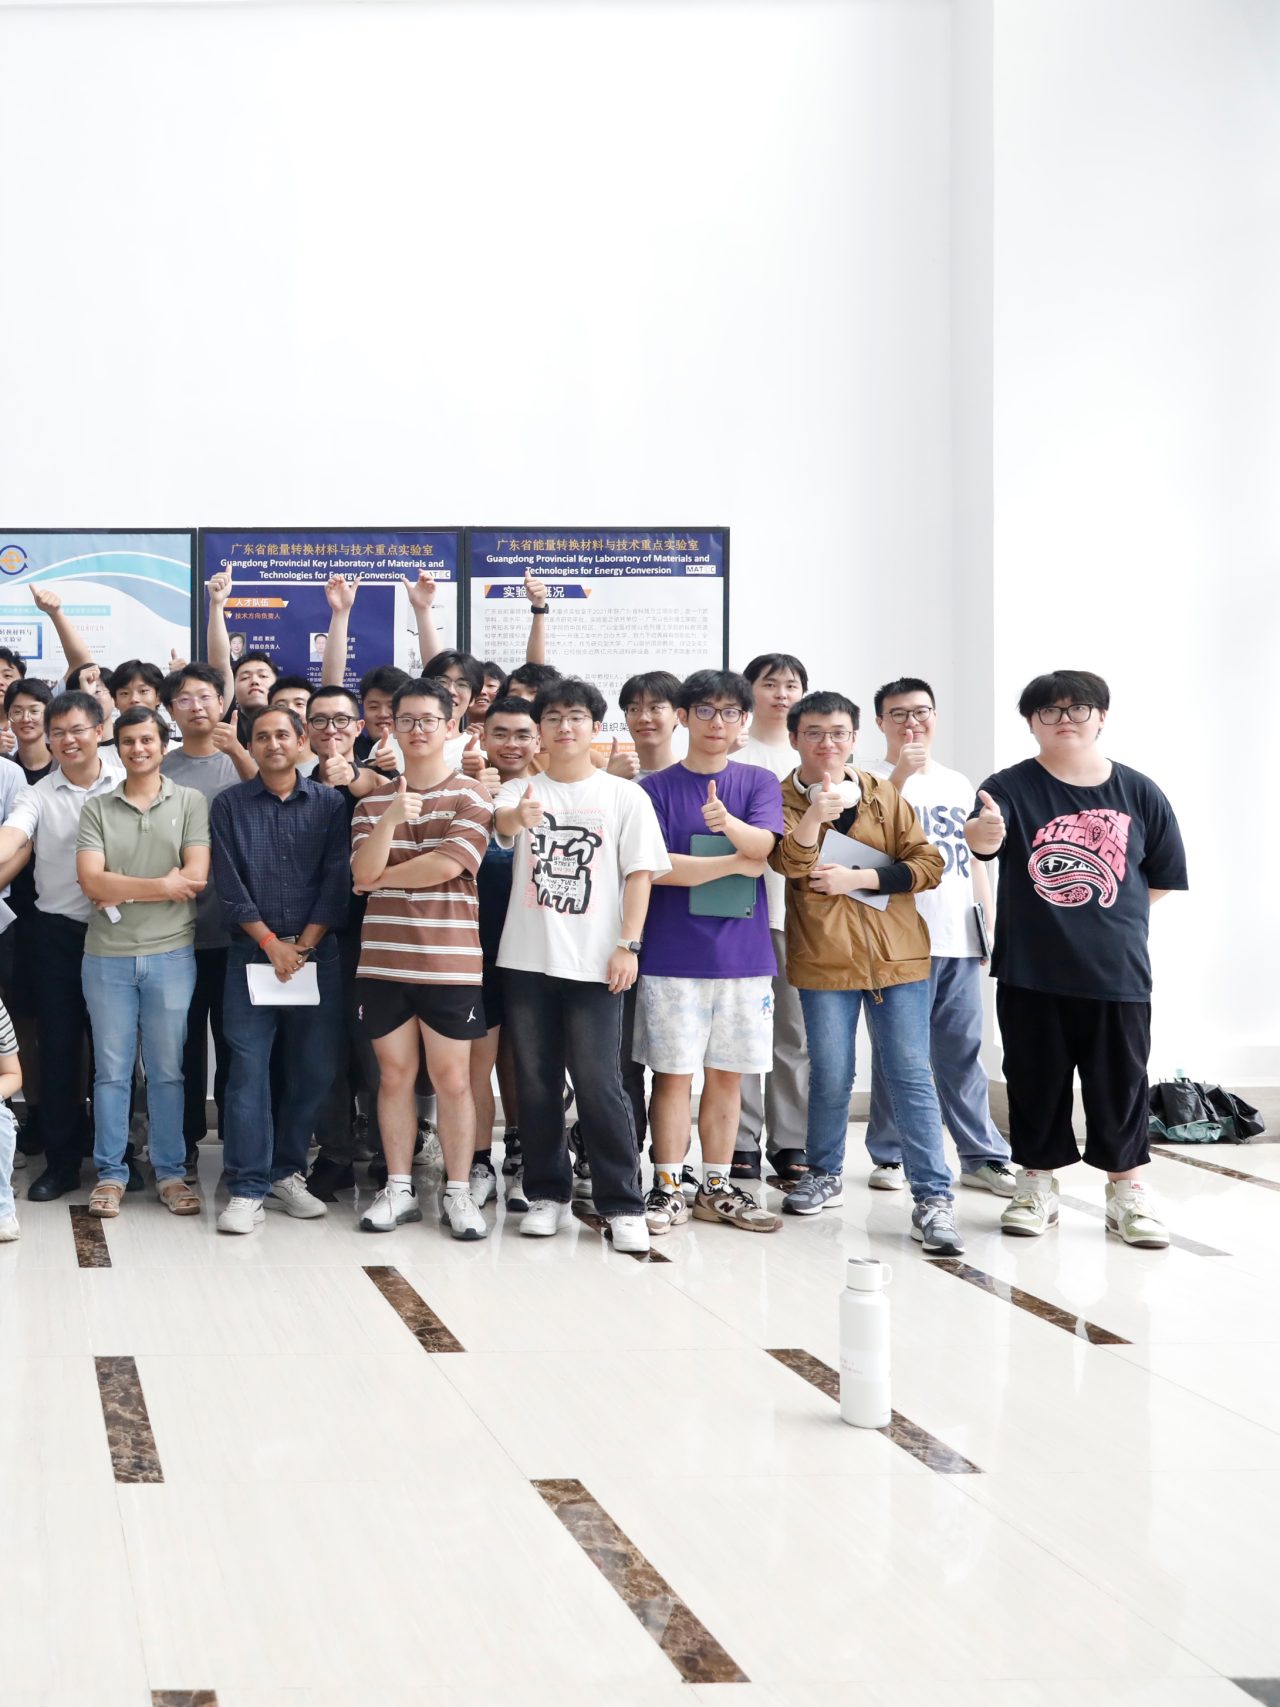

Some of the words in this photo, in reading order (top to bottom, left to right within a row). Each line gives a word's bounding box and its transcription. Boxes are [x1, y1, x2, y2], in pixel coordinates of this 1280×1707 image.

[231, 544, 433, 556] 广东省能量转换材料与技术重点实验室
[497, 539, 699, 551] 广东省能量转换材料与技术重点实验室
[220, 559, 268, 569] Guangdong
[270, 559, 310, 567] Provincial
[312, 560, 328, 568] Key
[330, 559, 375, 569] Laboratory
[376, 559, 386, 567] of
[388, 560, 426, 568] Materials
[428, 560, 444, 568] and
[486, 555, 534, 564] Guangdong
[536, 554, 576, 562] Provincial
[578, 554, 593, 564] Key
[595, 554, 641, 564] Laboratory
[642, 554, 652, 562] of
[653, 554, 692, 562] Materials
[694, 554, 710, 562] and
[259, 571, 312, 580] Technologies
[526, 566, 579, 576] Technologies
[580, 566, 592, 574] for
[594, 567, 624, 576] Energy
[625, 566, 671, 574] Conversion
[235, 599, 269, 607] 人才队伍
[719, 1201, 733, 1214] N
